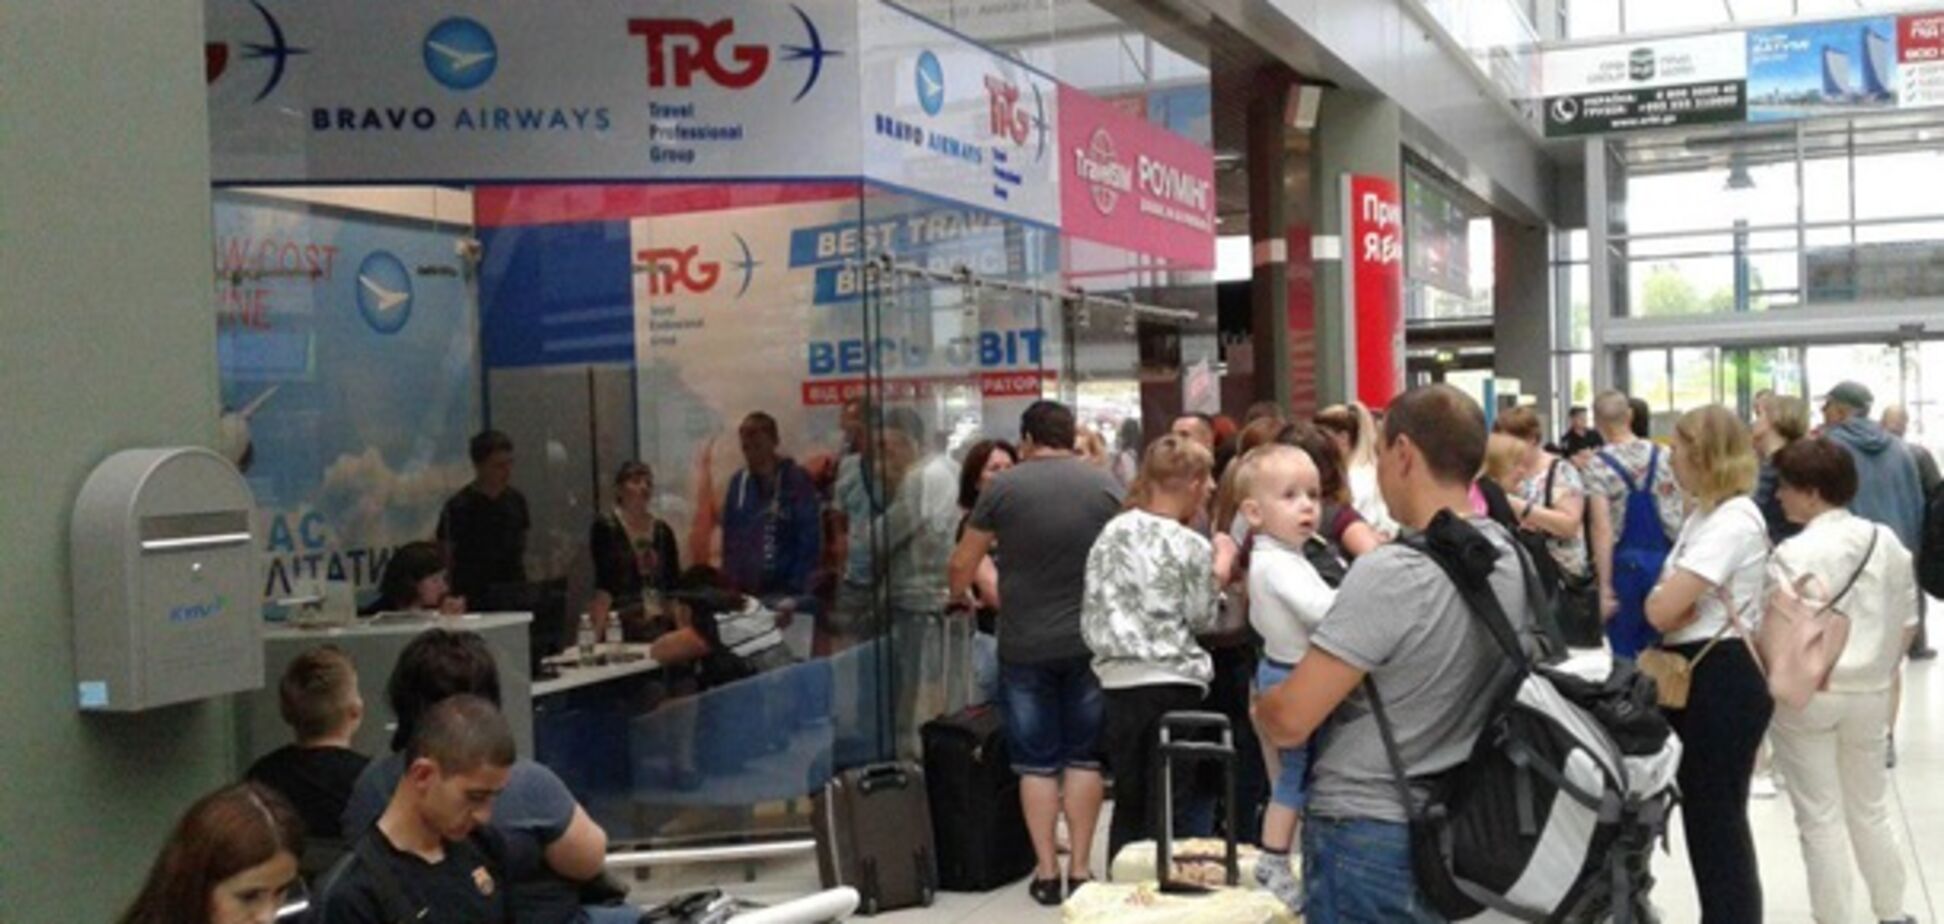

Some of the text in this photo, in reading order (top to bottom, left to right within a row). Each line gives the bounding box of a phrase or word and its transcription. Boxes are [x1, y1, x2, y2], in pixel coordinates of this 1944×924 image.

[628, 17, 770, 90] TPG
[312, 107, 612, 131] BRAVO AIRWAYS
[650, 102, 695, 118] Travel
[650, 147, 696, 165] Group
[875, 112, 924, 146] BRAVO
[927, 132, 983, 165] AIRWAYS
[817, 222, 897, 258] BEST
[637, 245, 720, 294] TPG
